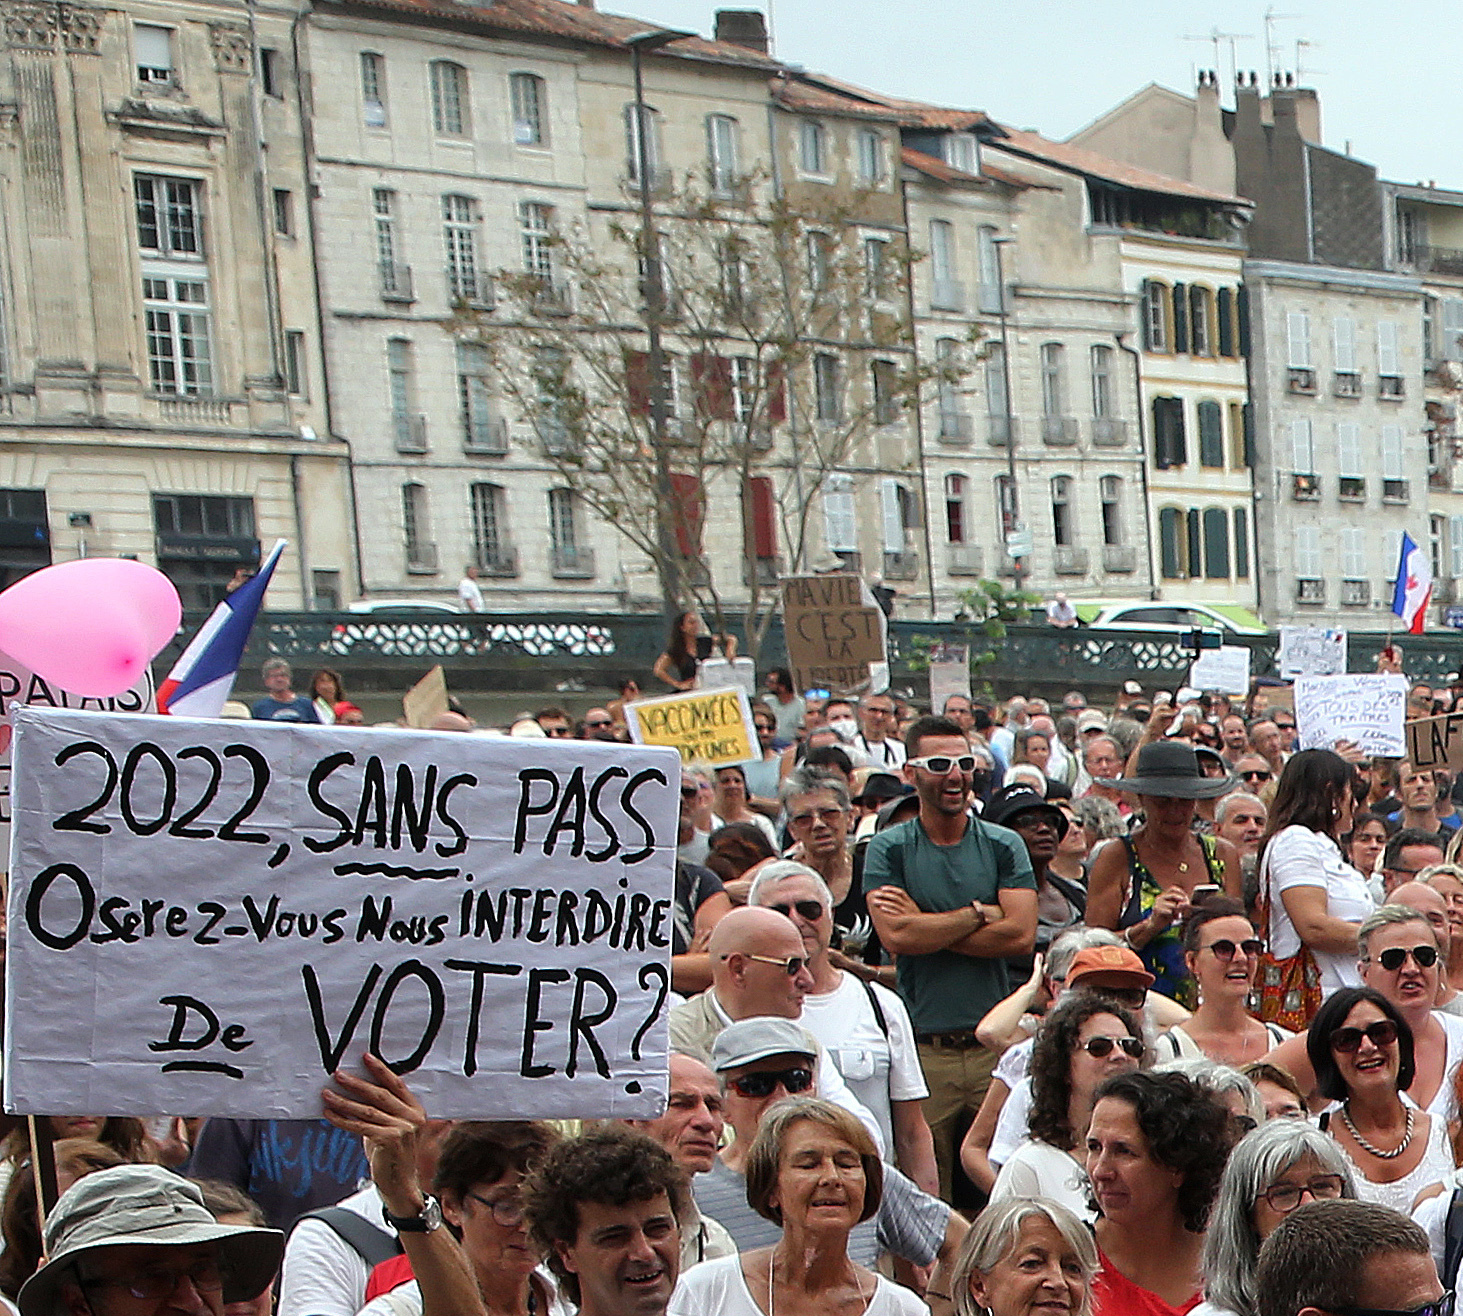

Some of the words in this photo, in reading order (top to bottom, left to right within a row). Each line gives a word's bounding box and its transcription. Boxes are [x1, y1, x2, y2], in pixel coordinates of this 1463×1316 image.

[53, 741, 290, 868] 2022,
[304, 752, 479, 857] SANS
[514, 766, 668, 866] PASS
[147, 995, 254, 1054] De
